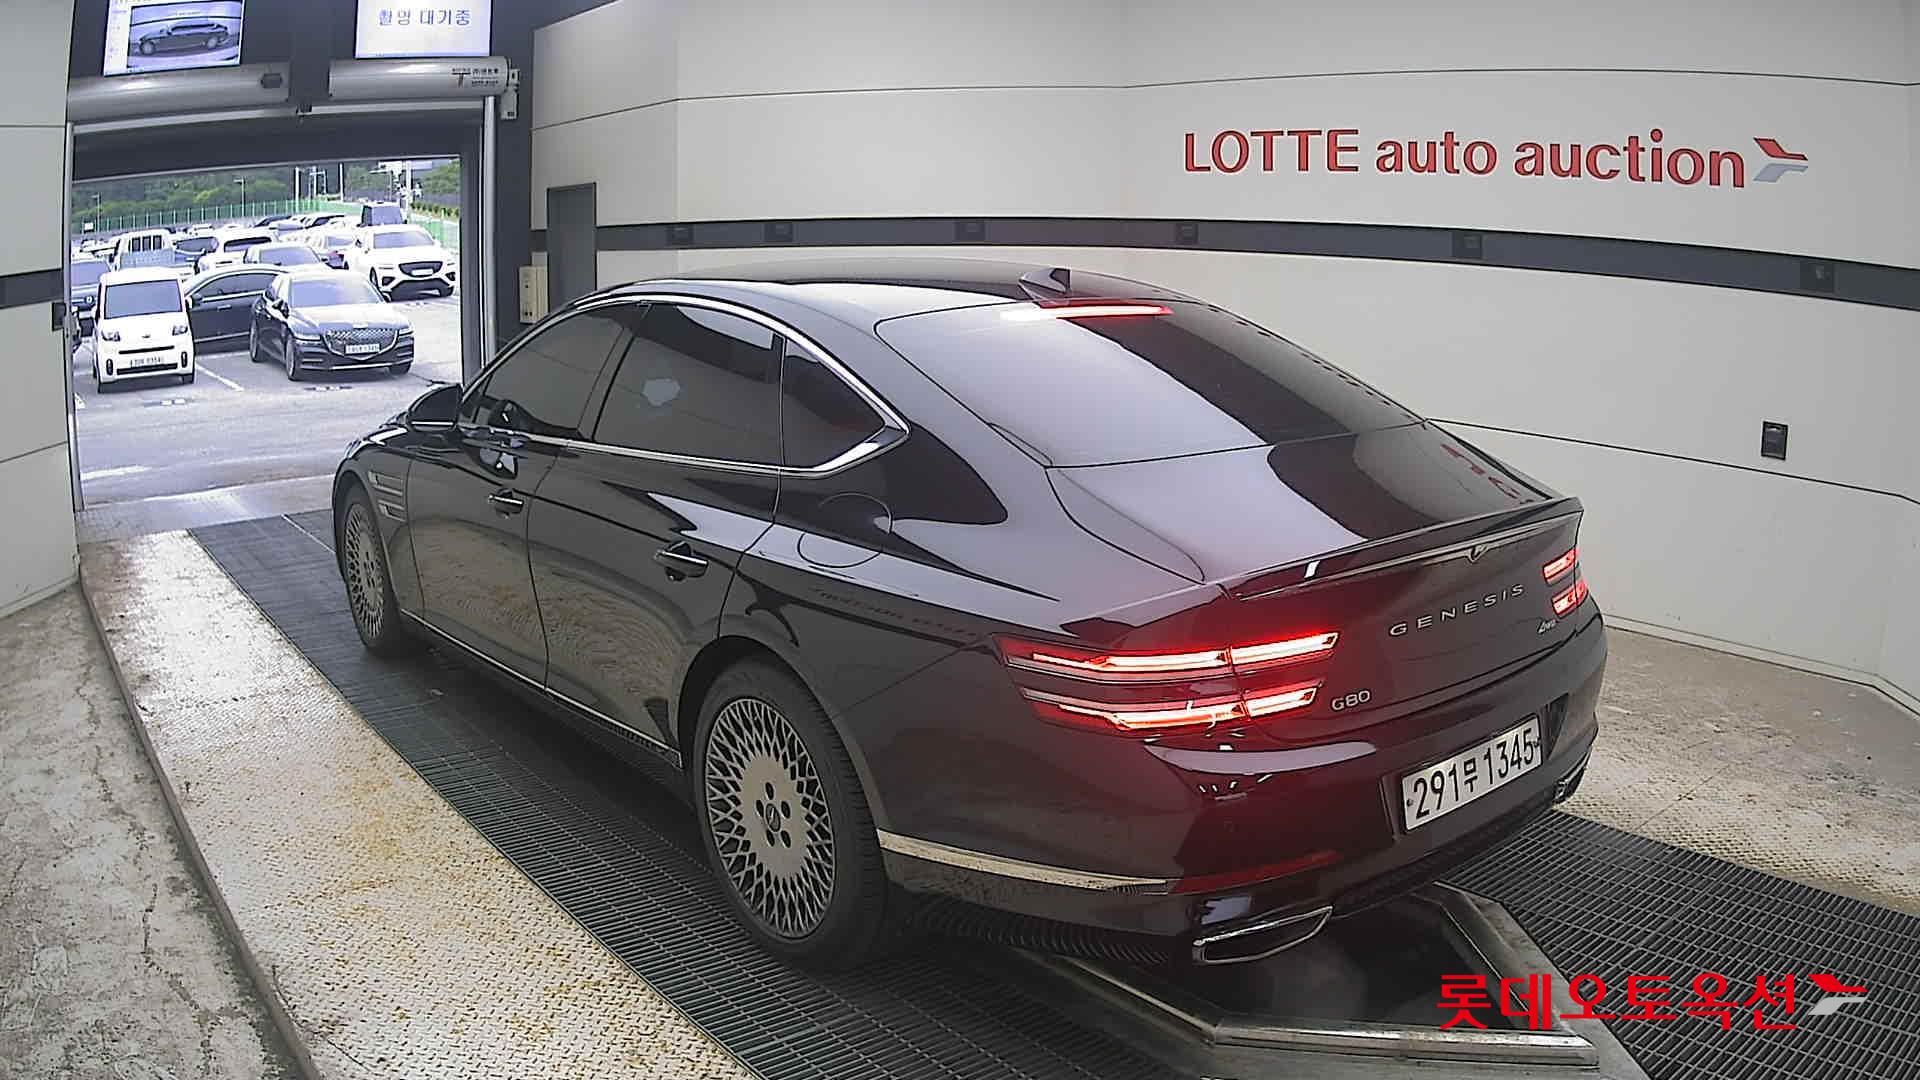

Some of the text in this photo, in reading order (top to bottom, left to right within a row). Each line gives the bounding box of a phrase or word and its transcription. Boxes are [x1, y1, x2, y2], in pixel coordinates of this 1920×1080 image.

[420, 9, 471, 26] 대기중
[1185, 128, 1746, 188] LOTTE auto auction
[1389, 583, 1525, 637] GENESIS
[1331, 689, 1371, 712] G80
